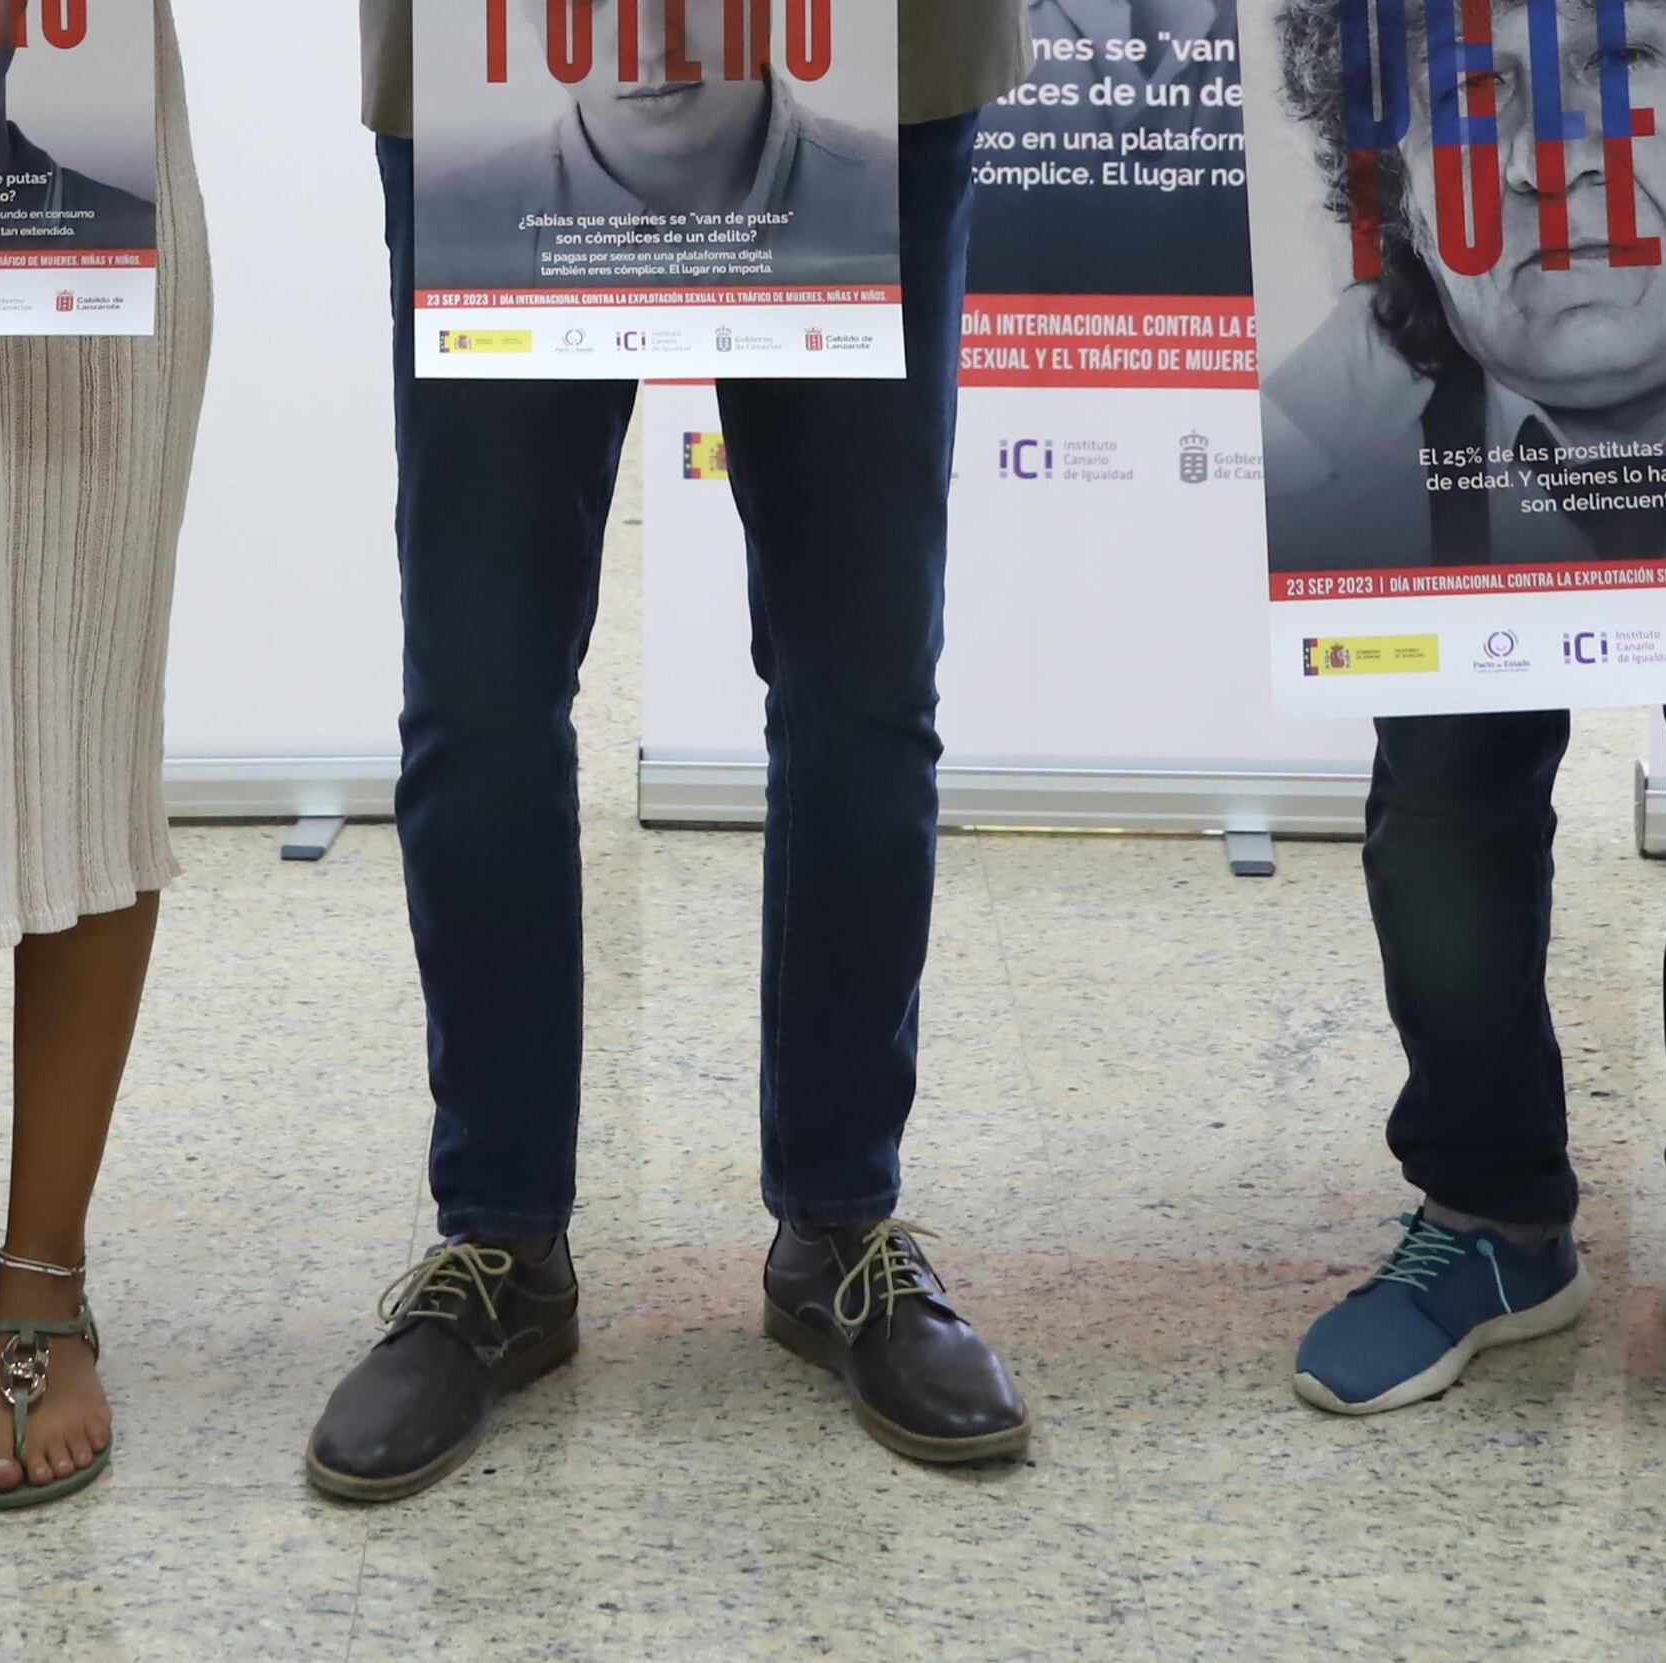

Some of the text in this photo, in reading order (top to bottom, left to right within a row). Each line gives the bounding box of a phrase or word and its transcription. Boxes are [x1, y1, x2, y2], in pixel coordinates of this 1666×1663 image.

[1105, 40, 1147, 61] se
[1158, 31, 1235, 61] "van
[1089, 76, 1135, 106] de
[1145, 82, 1195, 106] un
[1022, 127, 1245, 155] en una plataform
[6, 171, 53, 187] putas"
[1103, 162, 1245, 192] El lugar no
[518, 211, 794, 230] ¿Sabías que quienes se "van de putas"
[555, 229, 757, 247] son cómplices de un delito?
[541, 249, 772, 264] Si pagas por sexo en una plataforma digital
[540, 263, 772, 277] también eres cómplice. El lugar no importa.
[961, 309, 1241, 338] DÍA INTERNACIONAL CONTRA LA
[961, 348, 1029, 370] SEXUAL
[1035, 348, 1047, 370] Y
[1052, 349, 1073, 370] EL
[1078, 344, 1152, 370] TRÁFICO
[1158, 349, 1180, 370] DE
[1064, 439, 1118, 451] Instituto
[1419, 447, 1439, 466] El
[1442, 446, 1482, 467] 25%
[1487, 445, 1514, 463] de
[1519, 444, 1549, 462] las
[1554, 440, 1663, 465] prostitutas
[1064, 455, 1109, 466] Canario
[1064, 468, 1134, 483] de Igualdad
[1426, 473, 1452, 491] de
[1457, 470, 1513, 490] edad.
[1518, 470, 1532, 487] Y
[1537, 468, 1618, 490] quienes
[1623, 466, 1642, 483] lo
[1521, 499, 1557, 513] son
[1286, 578, 1304, 596] 23
[1308, 577, 1333, 595] SEP
[1337, 576, 1373, 594] 2023
[1390, 575, 1410, 592] DÍA
[1412, 574, 1505, 591] INTERNACIONAL
[1507, 572, 1554, 588] CONTRA
[1557, 571, 1572, 586] LA
[1574, 567, 1654, 586] EXPLOTACIÓN
[1616, 630, 1661, 640] Instituto
[1616, 641, 1655, 652] Canario
[1617, 653, 1629, 663] de
